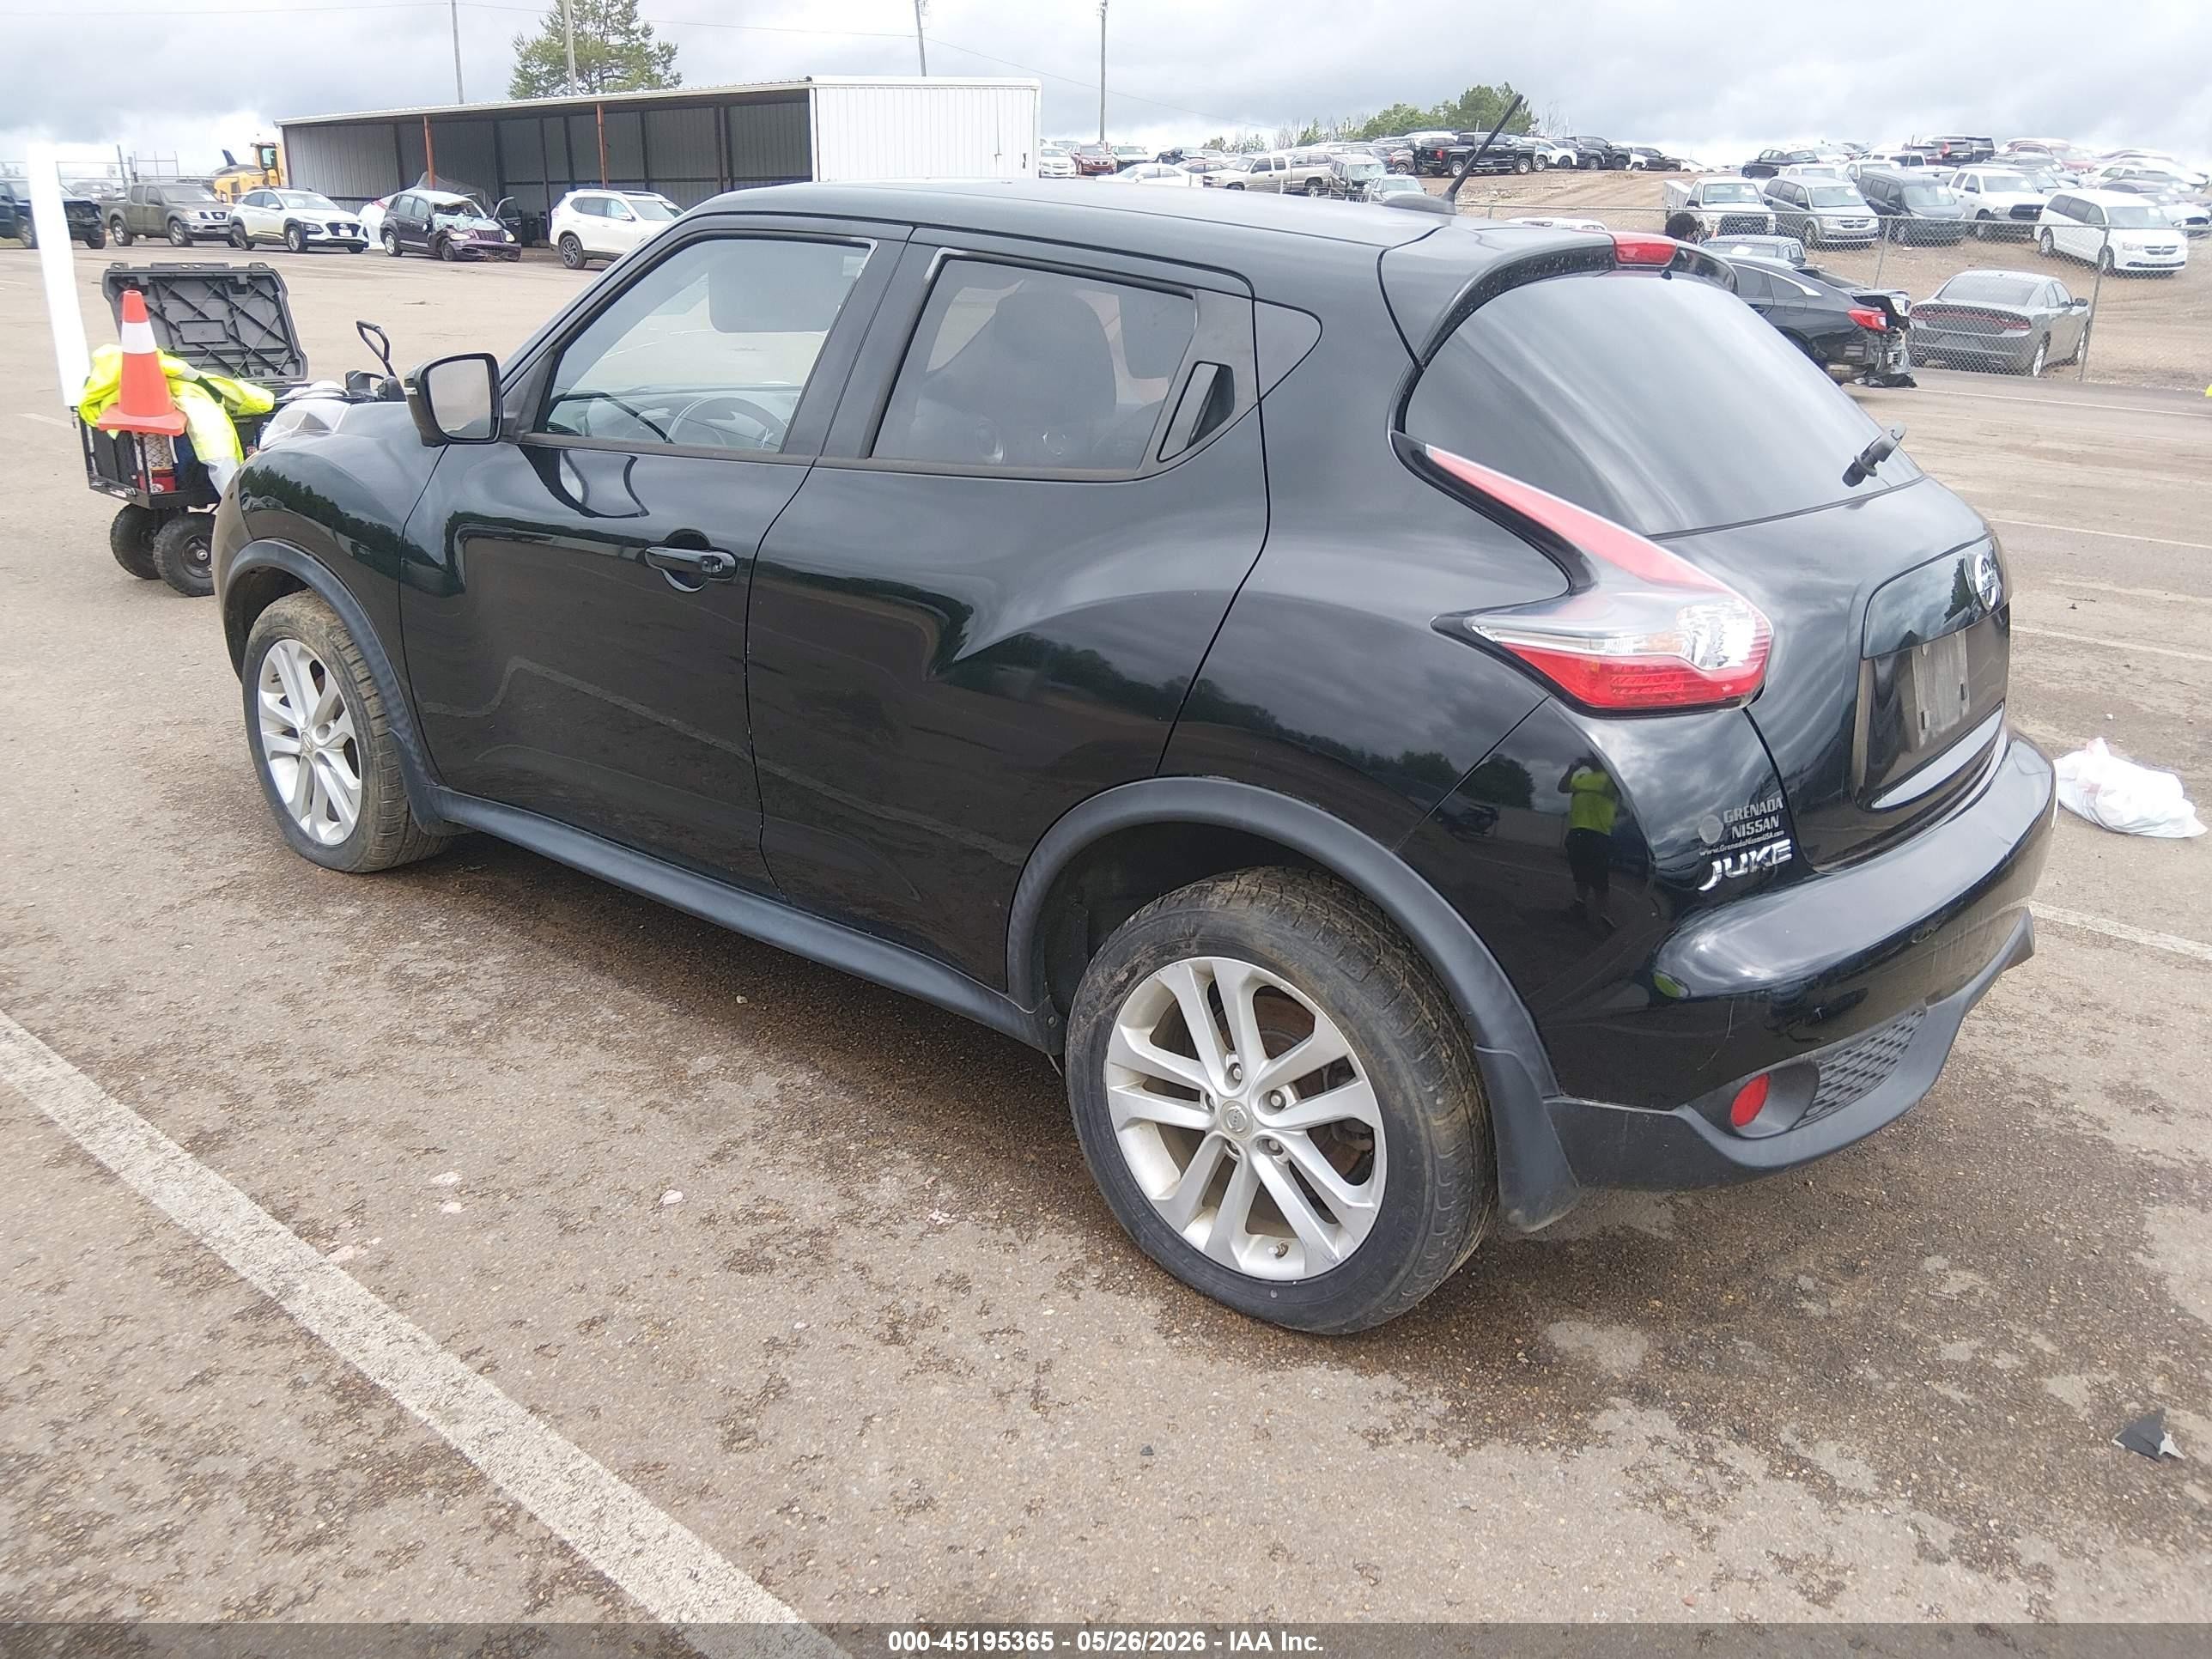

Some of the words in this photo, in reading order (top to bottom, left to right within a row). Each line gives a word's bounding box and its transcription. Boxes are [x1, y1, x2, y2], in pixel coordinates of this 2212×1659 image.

[1723, 797, 1784, 823] GRENADA
[1731, 814, 1779, 839] NISSAN
[1698, 838, 1793, 891] JUKE
